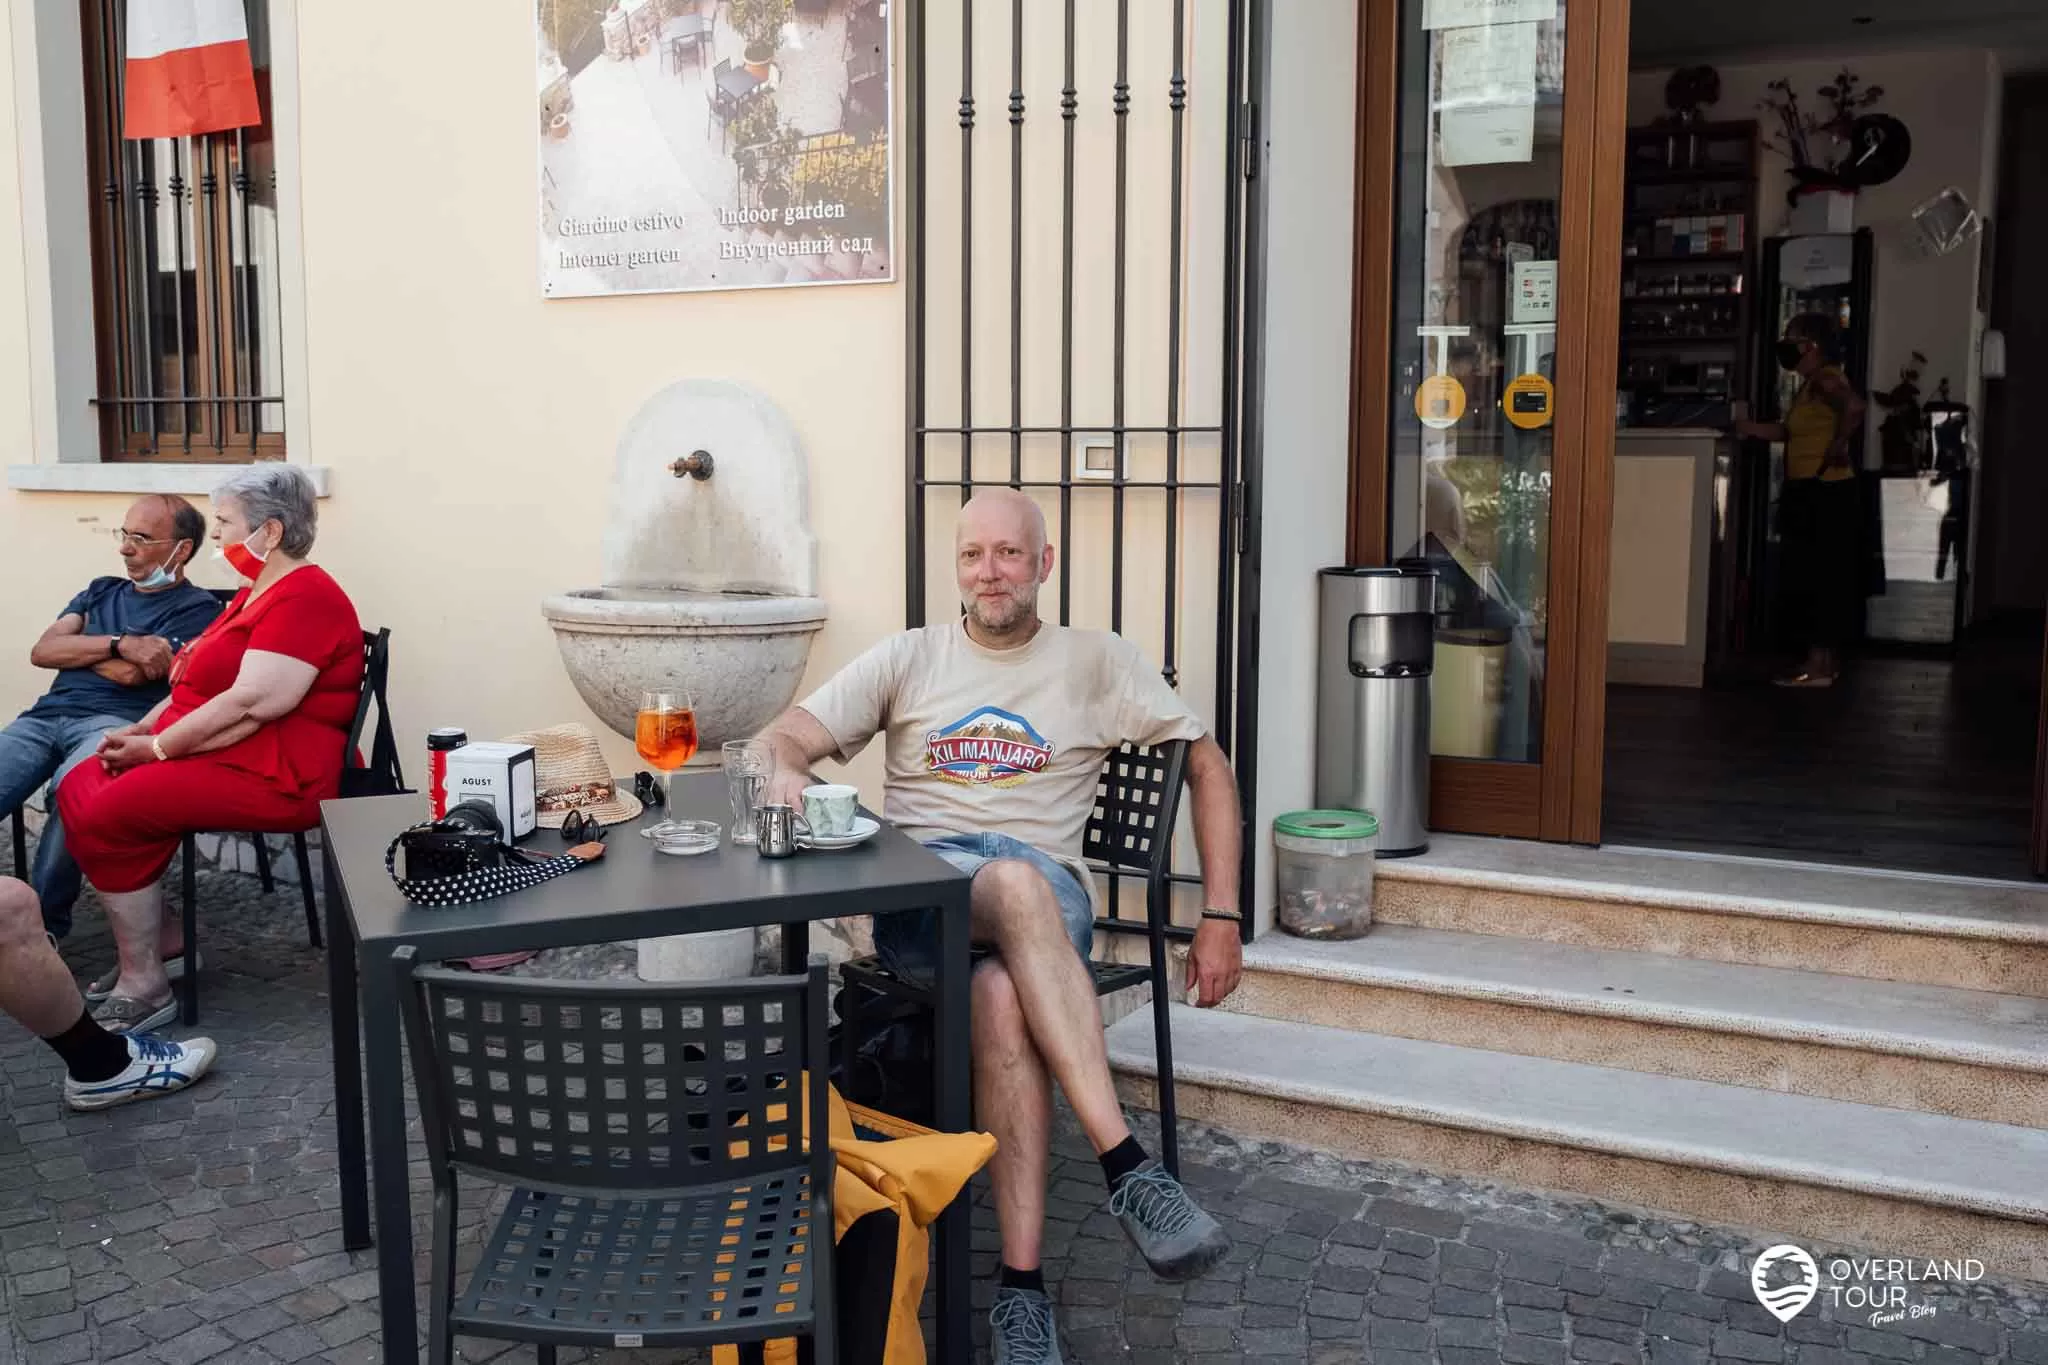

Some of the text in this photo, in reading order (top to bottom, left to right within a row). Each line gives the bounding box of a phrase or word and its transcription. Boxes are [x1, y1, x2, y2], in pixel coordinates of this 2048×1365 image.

[558, 208, 685, 237] Giardino estivo
[719, 199, 846, 226] Indoor garden
[559, 247, 681, 270] Interner garten
[719, 235, 874, 263] Внутренний сад
[931, 741, 1046, 769] KILIMANJARO
[462, 778, 492, 787] AGUST
